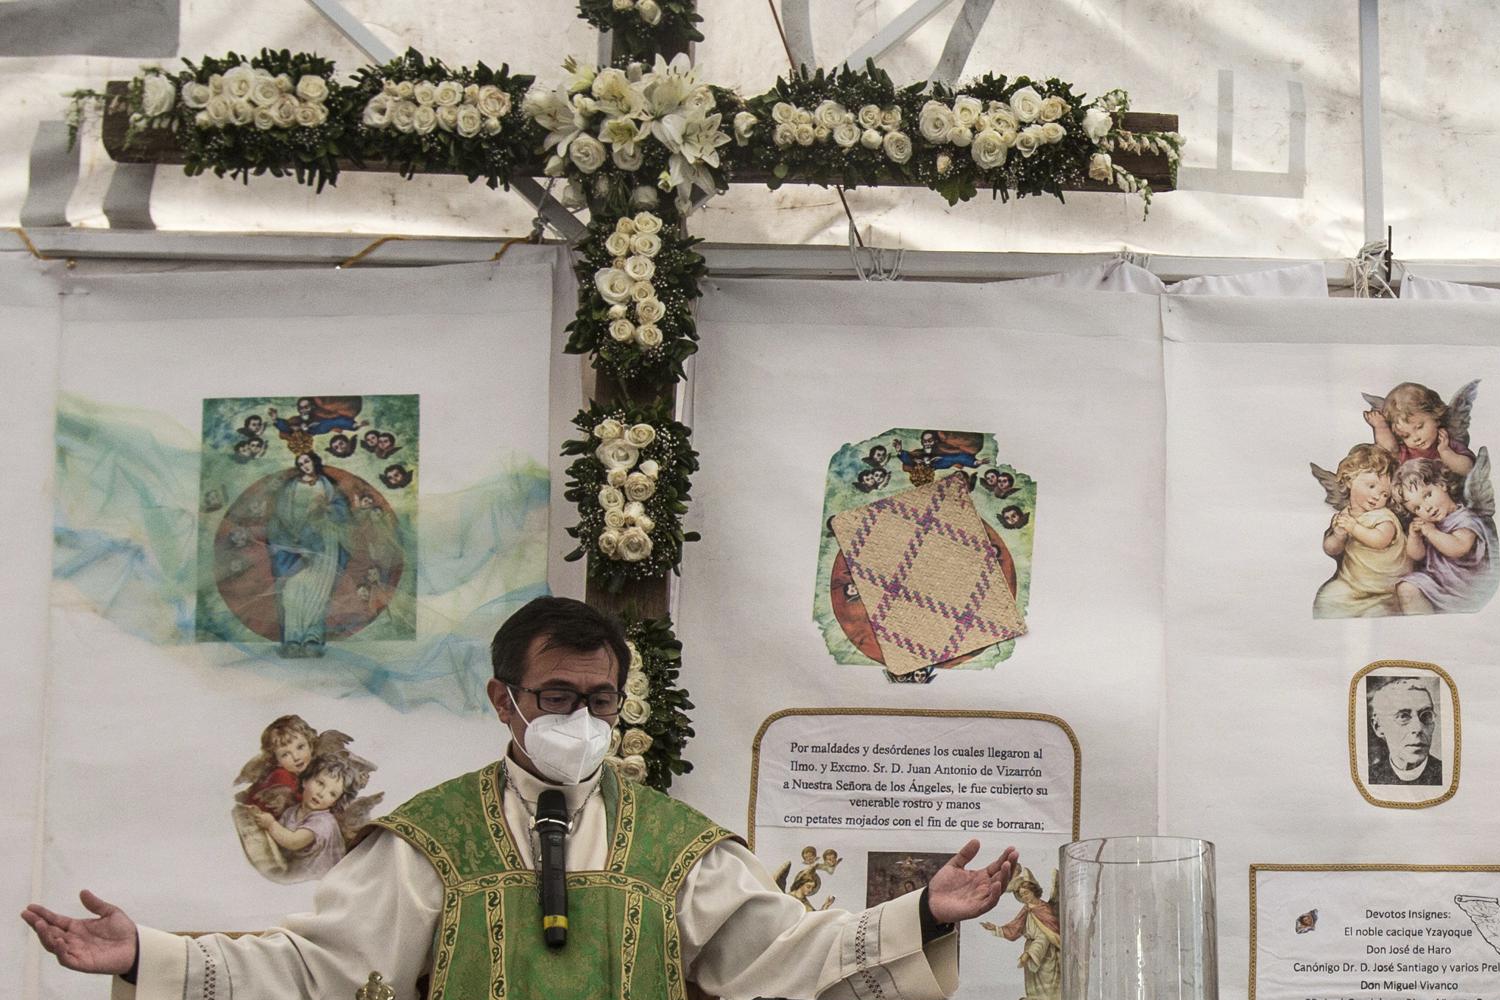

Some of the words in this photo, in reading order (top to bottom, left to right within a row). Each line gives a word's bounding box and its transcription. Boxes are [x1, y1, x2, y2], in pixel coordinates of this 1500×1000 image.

[790, 742, 808, 753] Por
[811, 743, 860, 754] maldades
[862, 746, 870, 757] y
[872, 744, 931, 756] desórdenes
[934, 745, 949, 757] los
[952, 746, 985, 758] cuales
[988, 747, 1030, 760] llegaron
[1033, 748, 1043, 760] al
[820, 763, 828, 774] y
[830, 761, 870, 773] Excmo.
[873, 762, 888, 773] Sr.
[891, 763, 904, 774] D.
[907, 764, 931, 775] Juan
[933, 764, 978, 776] Antonio
[980, 765, 993, 776] de
[996, 765, 1042, 777] Vizarrón
[783, 780, 790, 789] a
[792, 779, 833, 790] Nuestra
[835, 779, 872, 791] Señora
[874, 780, 888, 791] de
[890, 781, 906, 792] los
[908, 779, 954, 795] Ángeles,
[958, 783, 967, 793] le
[970, 783, 987, 794] fue
[990, 783, 1033, 796] cubierto
[1036, 786, 1048, 796] su
[849, 797, 900, 808] venerable
[902, 799, 934, 810] rostro
[936, 802, 943, 812] y
[946, 801, 981, 810] manos
[783, 815, 803, 824] con
[805, 815, 842, 827] petates
[845, 815, 890, 828] mojados
[892, 818, 912, 827] con
[914, 817, 924, 828] el
[927, 817, 941, 828] fin
[944, 817, 957, 828] de
[960, 820, 980, 831] que
[982, 820, 993, 829] se
[996, 818, 1045, 831] borraran;
[1365, 909, 1406, 920] Devotos
[1408, 909, 1451, 921] Insignes:
[1344, 927, 1353, 937] El
[1355, 927, 1383, 937] noble
[1386, 927, 1423, 938] cacique
[1425, 927, 1473, 939] Yzayoque
[1366, 945, 1387, 955] Don
[1389, 944, 1410, 955] José
[1412, 945, 1425, 955] de
[1427, 945, 1452, 955] Haro
[1293, 962, 1340, 974] Canónigo
[1342, 963, 1357, 973] Dr.
[1360, 963, 1370, 973] D.
[1373, 962, 1394, 973] José
[1396, 963, 1439, 974] Santiago
[1441, 966, 1448, 974] y
[1450, 963, 1479, 973] varios
[1360, 981, 1380, 991] Don
[1383, 980, 1417, 992] Miguel
[1420, 980, 1459, 991] Vivanco
